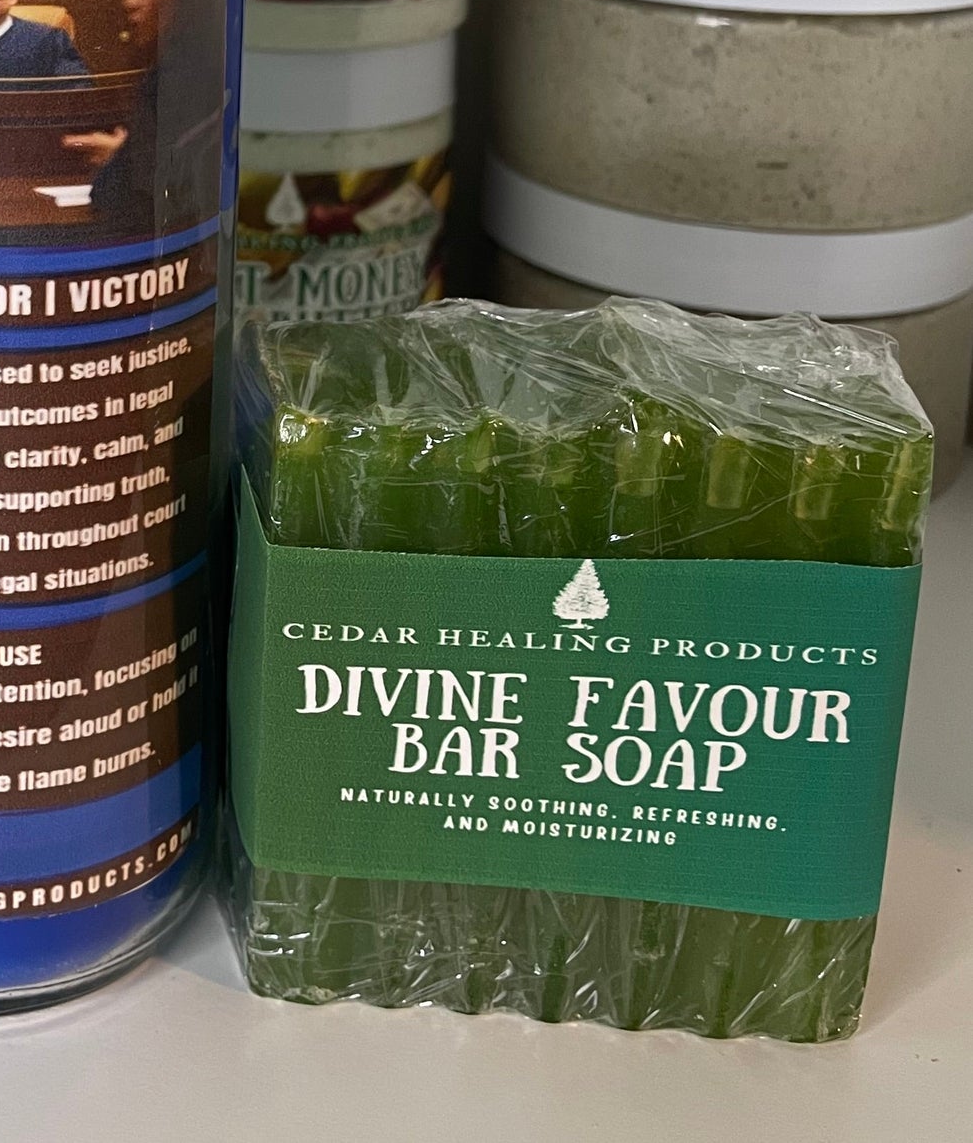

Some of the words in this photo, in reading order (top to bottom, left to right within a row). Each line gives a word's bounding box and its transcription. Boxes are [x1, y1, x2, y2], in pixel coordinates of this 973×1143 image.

[69, 258, 189, 313] VICTORY
[39, 362, 63, 384] to
[70, 355, 123, 380] seek
[104, 395, 125, 417] in
[128, 380, 174, 412] legal
[153, 415, 184, 446] and
[16, 513, 139, 553] throughout
[143, 494, 186, 528] court
[43, 549, 154, 590] situations.
[94, 642, 177, 690] focusing
[180, 626, 198, 653] on
[281, 622, 420, 645] CEDAR
[437, 628, 632, 654] HEALING
[650, 638, 880, 666] PRODUCTS
[58, 709, 122, 741] aloud
[126, 701, 148, 725] or
[151, 678, 187, 713] hold
[295, 664, 527, 725] DIVINE
[567, 675, 852, 744] FAVOUR
[18, 762, 86, 792] flame
[93, 739, 156, 779] burns.
[388, 723, 521, 780] BAR
[561, 732, 748, 793] SOAP
[340, 787, 475, 810] NATURALLY
[443, 815, 489, 833] AND
[502, 818, 678, 847] MOISTURIZING
